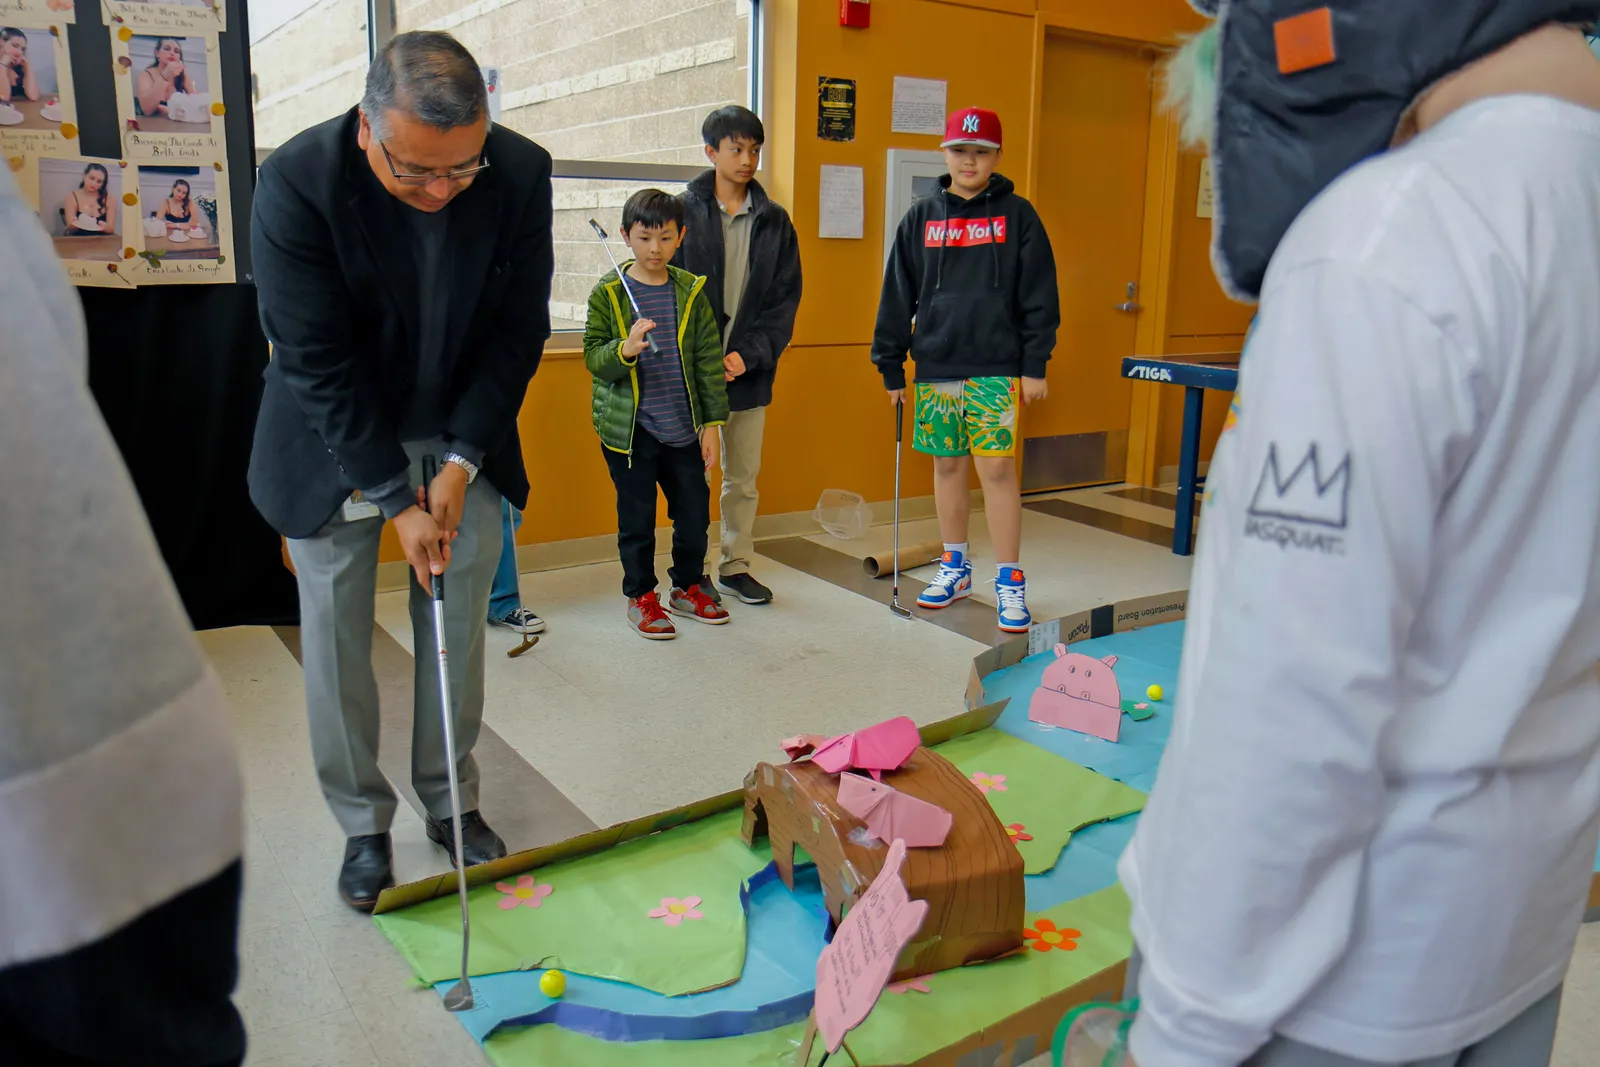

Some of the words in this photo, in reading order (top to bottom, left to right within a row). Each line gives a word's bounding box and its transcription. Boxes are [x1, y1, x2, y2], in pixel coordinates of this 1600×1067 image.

[927, 225, 963, 241] New
[966, 220, 1003, 240] York
[1128, 365, 1172, 381] STIGA
[1117, 611, 1140, 624] Board
[1141, 603, 1185, 617] Presentation
